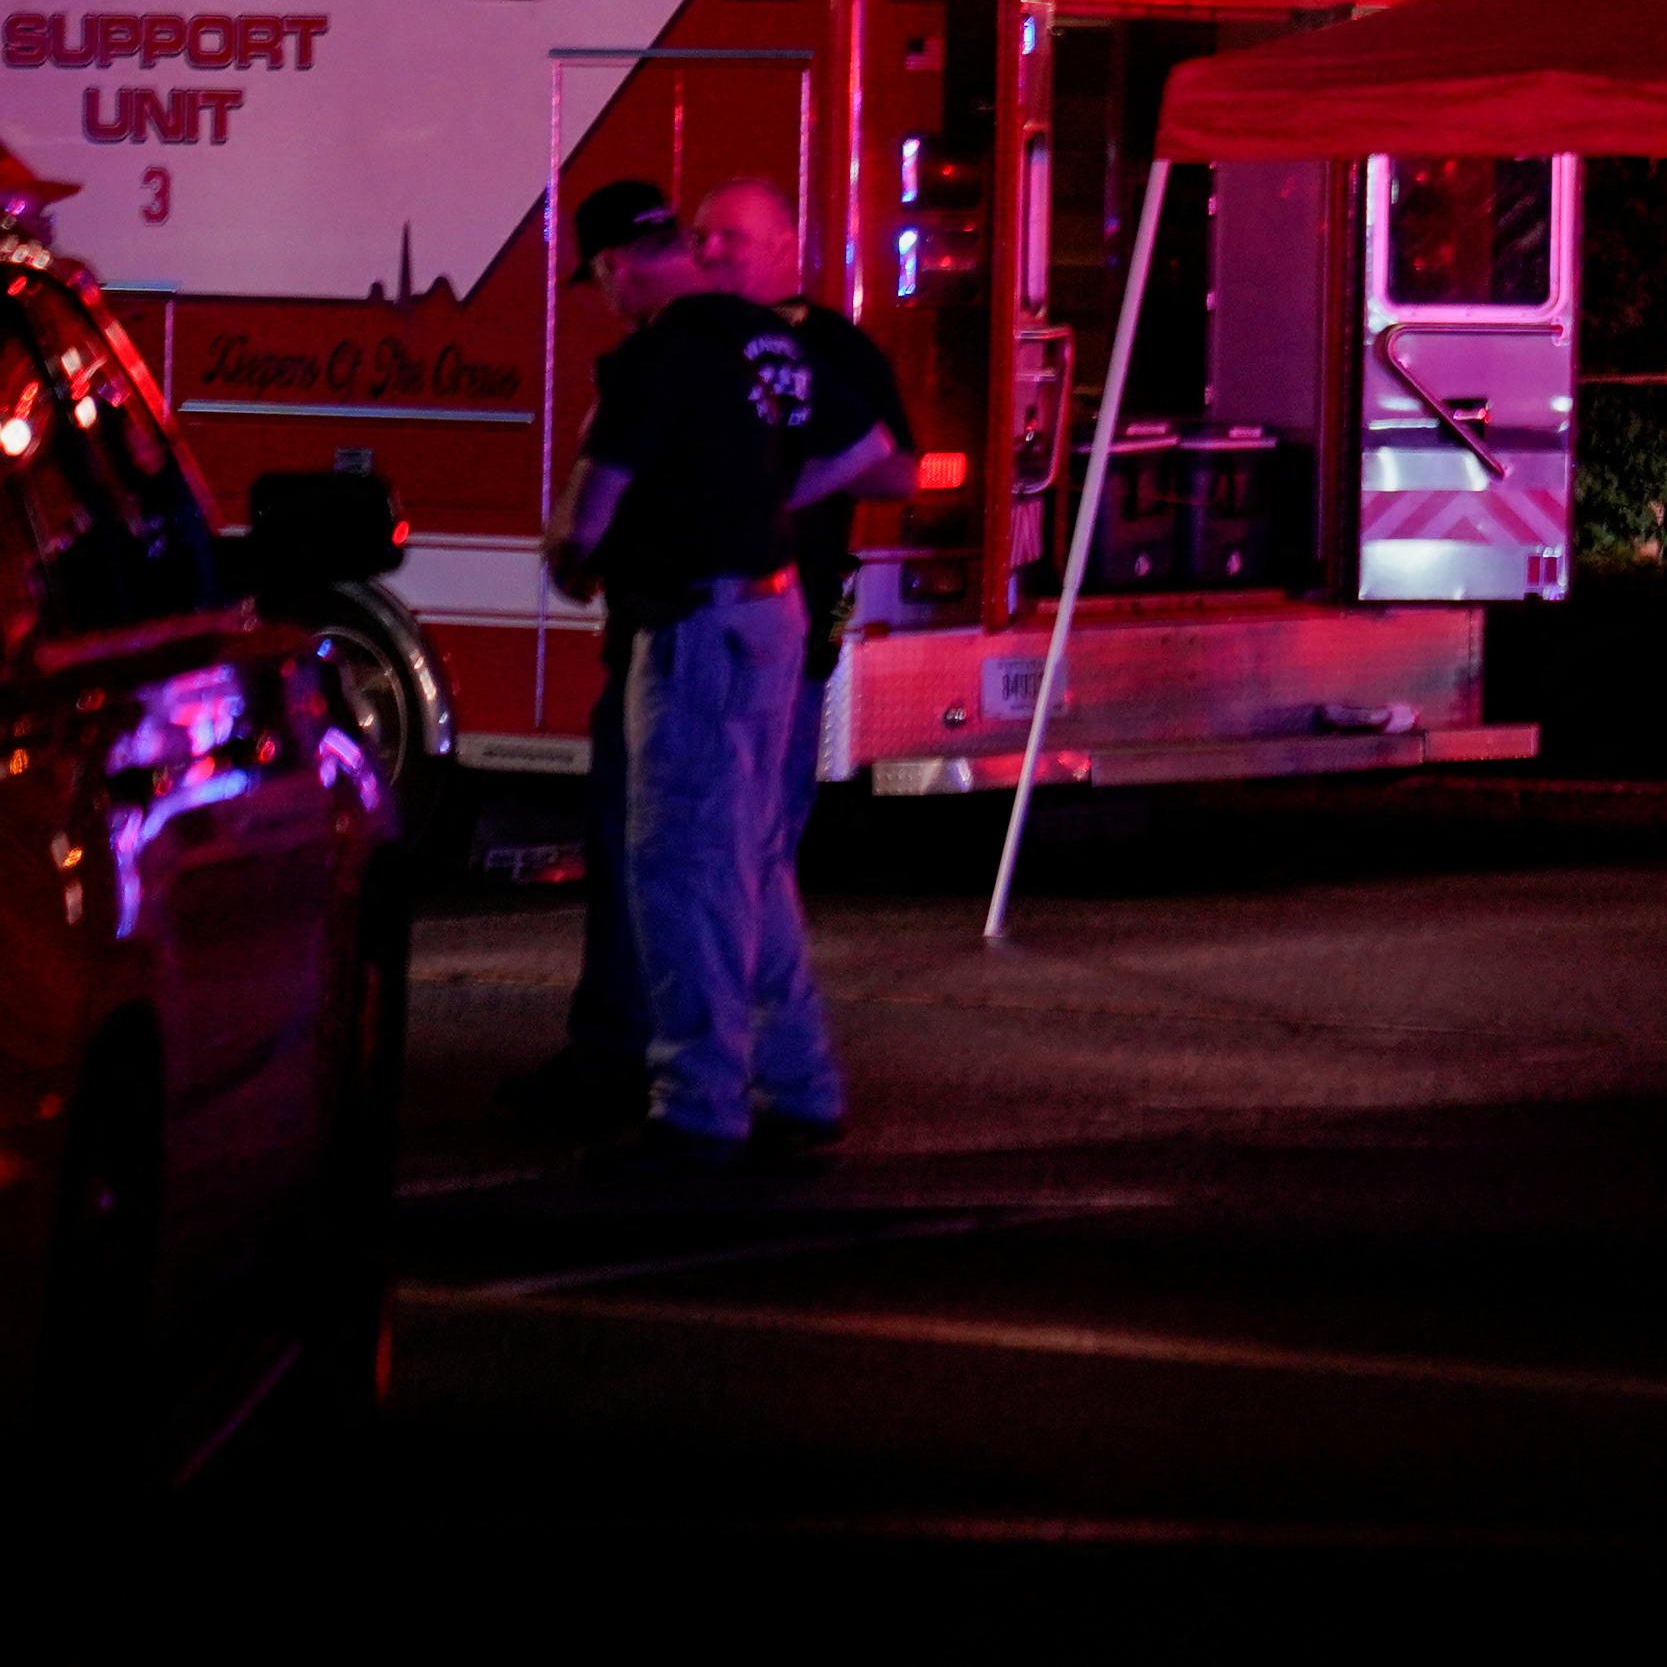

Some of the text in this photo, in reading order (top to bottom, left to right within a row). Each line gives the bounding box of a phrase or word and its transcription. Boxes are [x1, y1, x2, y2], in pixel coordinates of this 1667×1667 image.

[3, 13, 330, 71] SUPPORT
[83, 86, 243, 145] UNIT
[140, 166, 172, 227] 3
